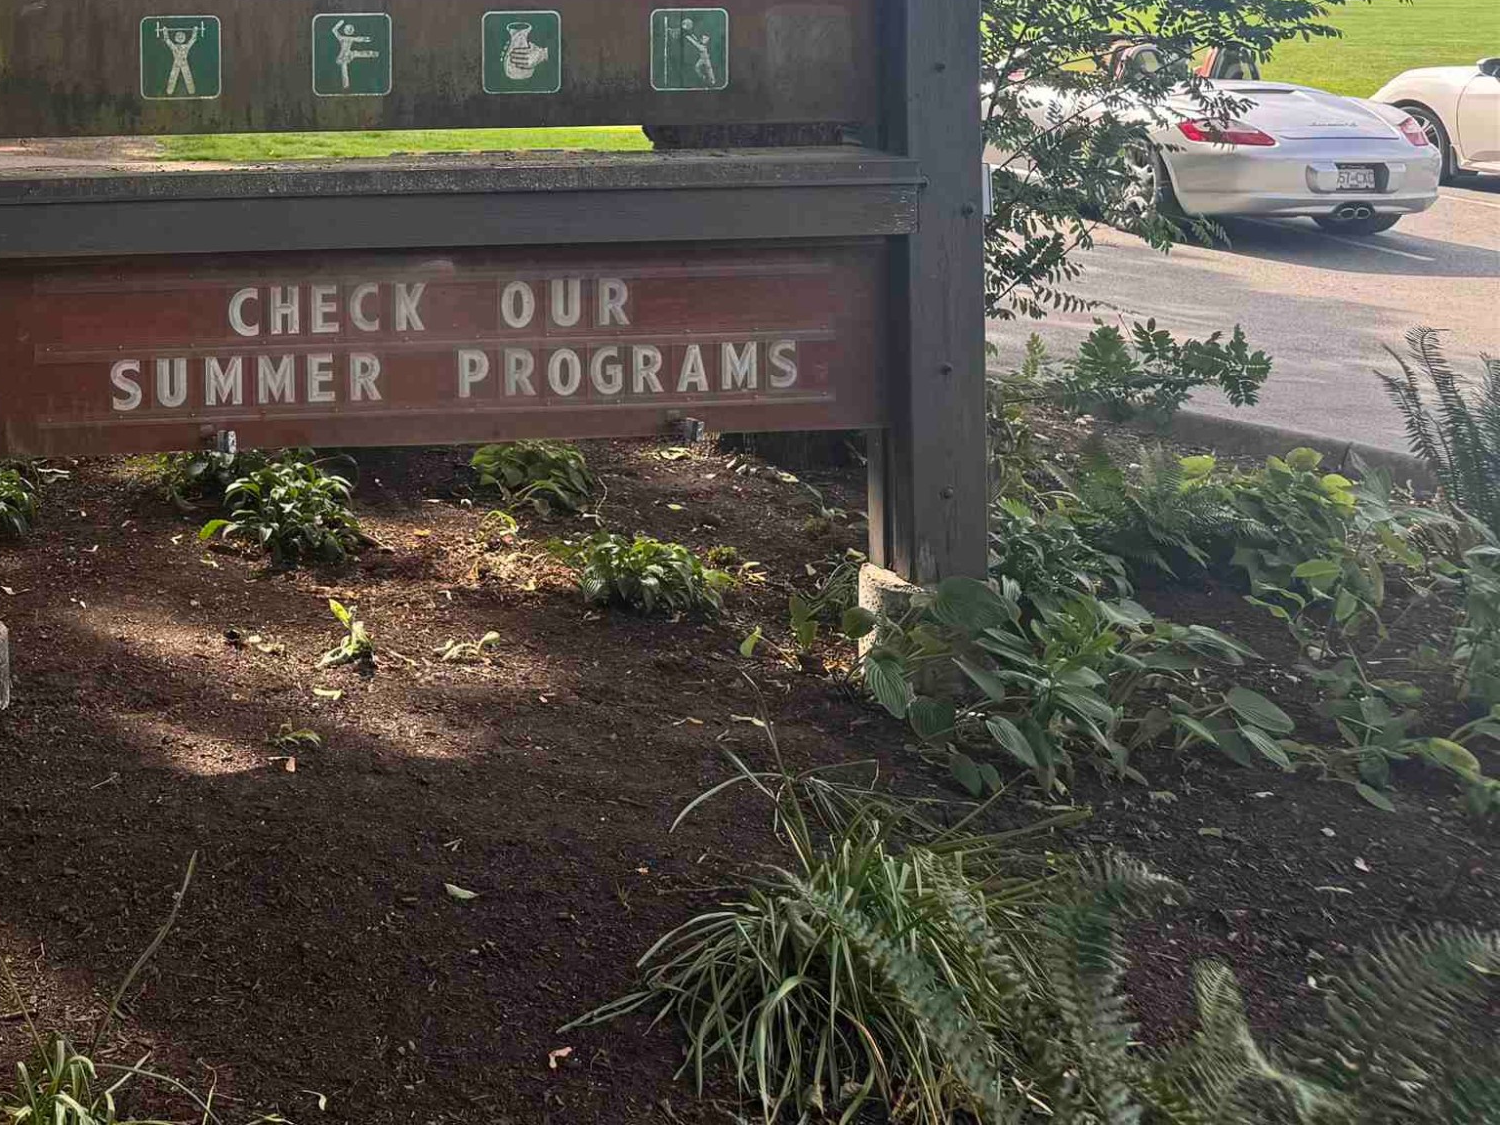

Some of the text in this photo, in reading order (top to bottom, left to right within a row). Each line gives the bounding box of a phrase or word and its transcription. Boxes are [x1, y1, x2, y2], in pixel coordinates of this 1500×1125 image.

[228, 276, 631, 337] CHECK OUR
[109, 338, 799, 412] SUMMER PROGRAMS
